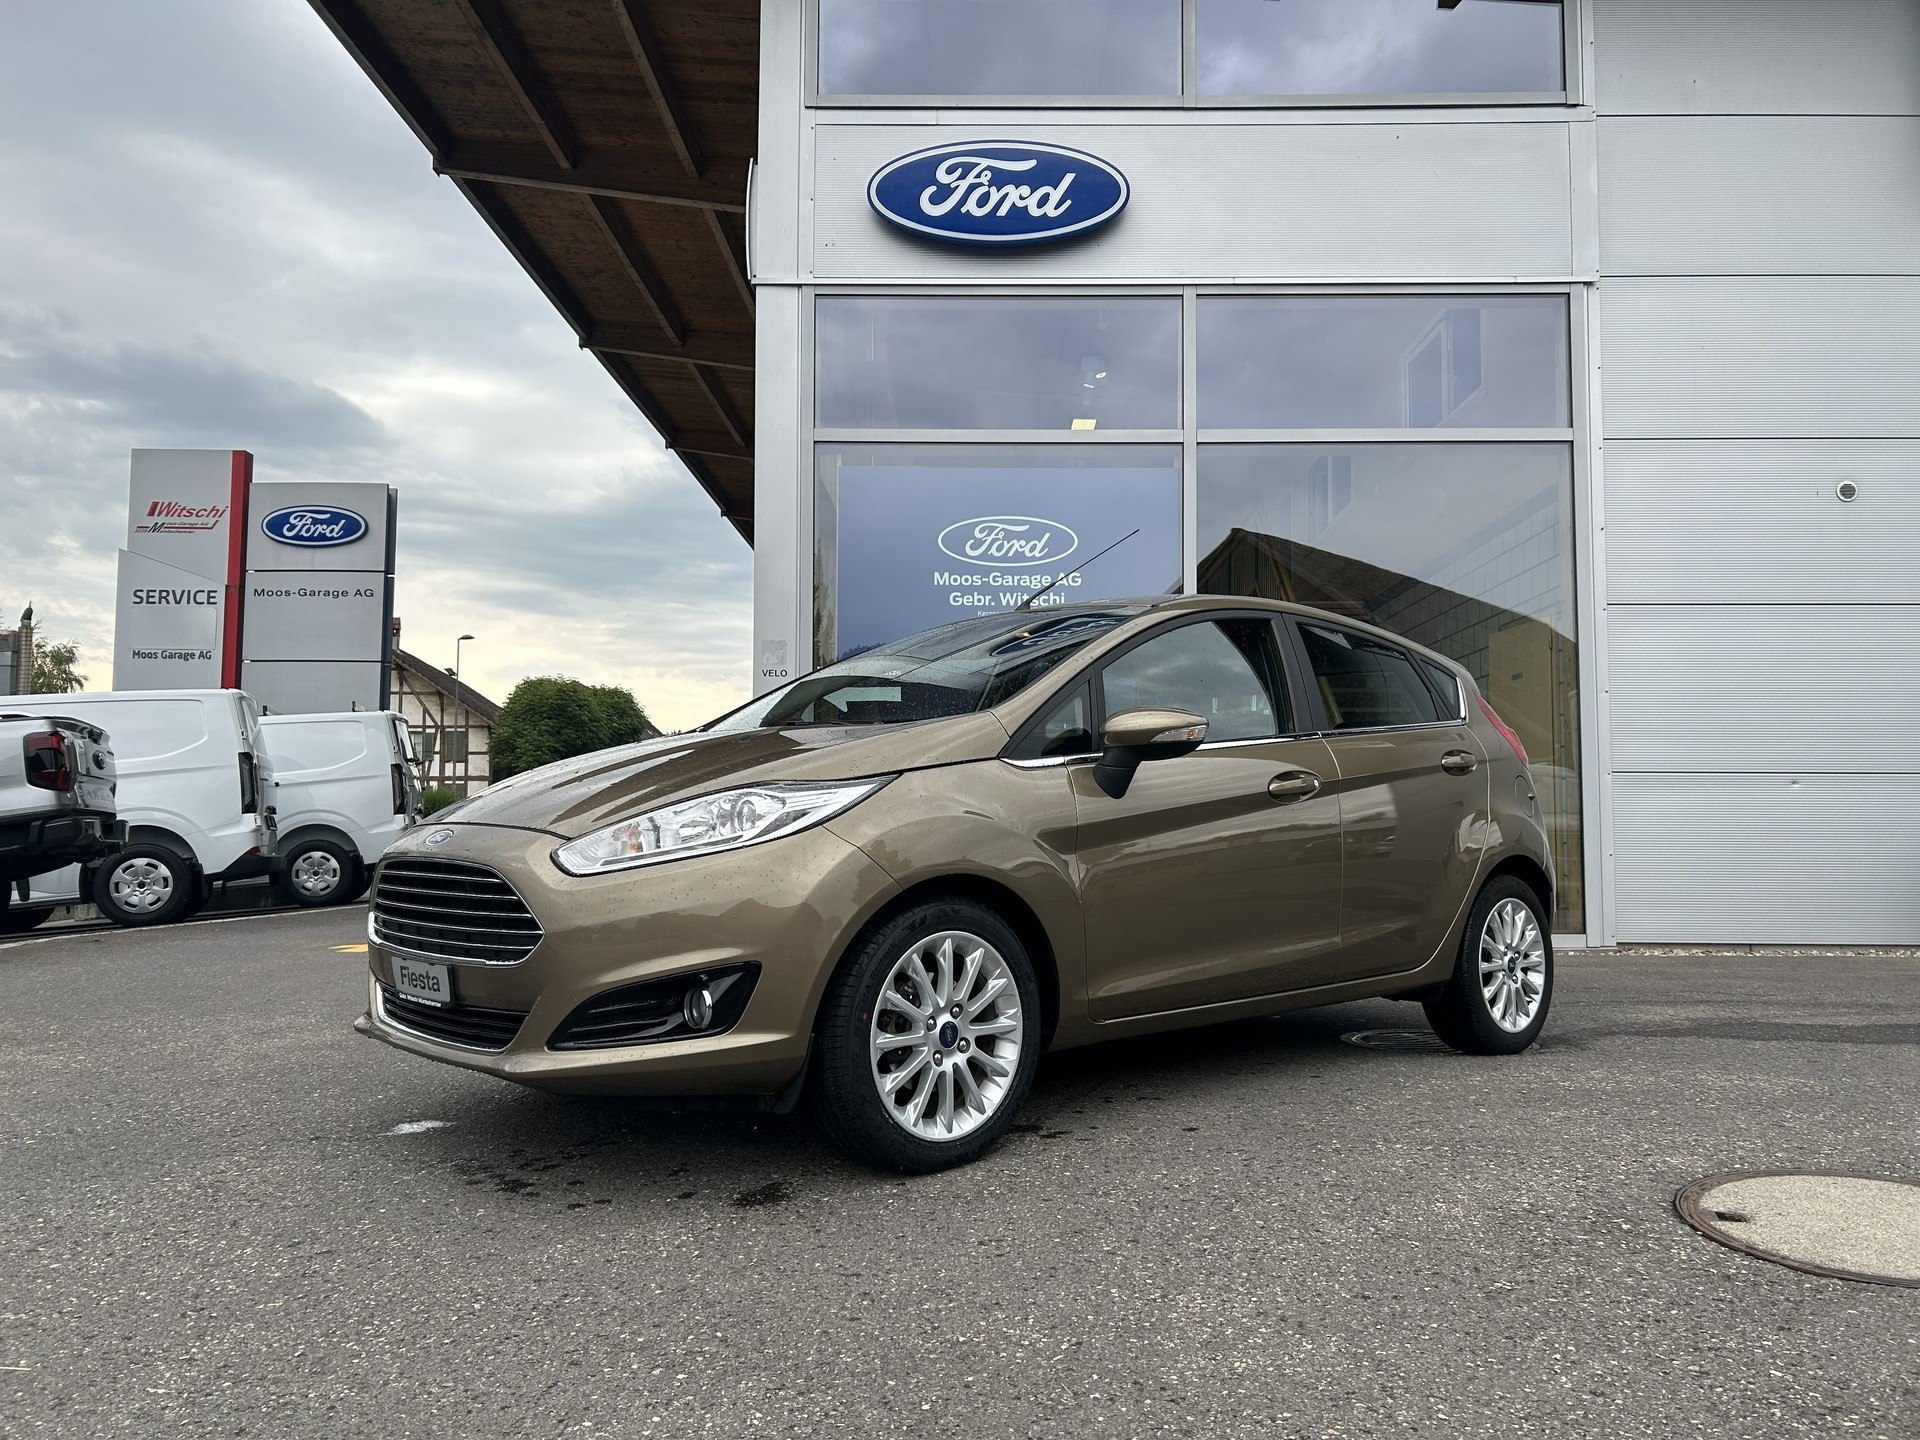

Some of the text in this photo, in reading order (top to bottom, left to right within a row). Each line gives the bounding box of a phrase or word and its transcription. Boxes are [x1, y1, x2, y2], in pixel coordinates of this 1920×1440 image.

[919, 156, 1077, 217] Ford
[156, 501, 229, 518] Witschi
[282, 511, 346, 538] Ford
[964, 522, 1051, 557] Ford
[933, 571, 1082, 588] Moos-Garage AG
[132, 589, 218, 605] SERVICE
[253, 588, 374, 599] Moos-Garage AG
[949, 591, 995, 606] Gebr.
[132, 650, 212, 662] Moos Garage AG
[761, 669, 788, 677] VELO
[399, 965, 441, 993] Fiesta
